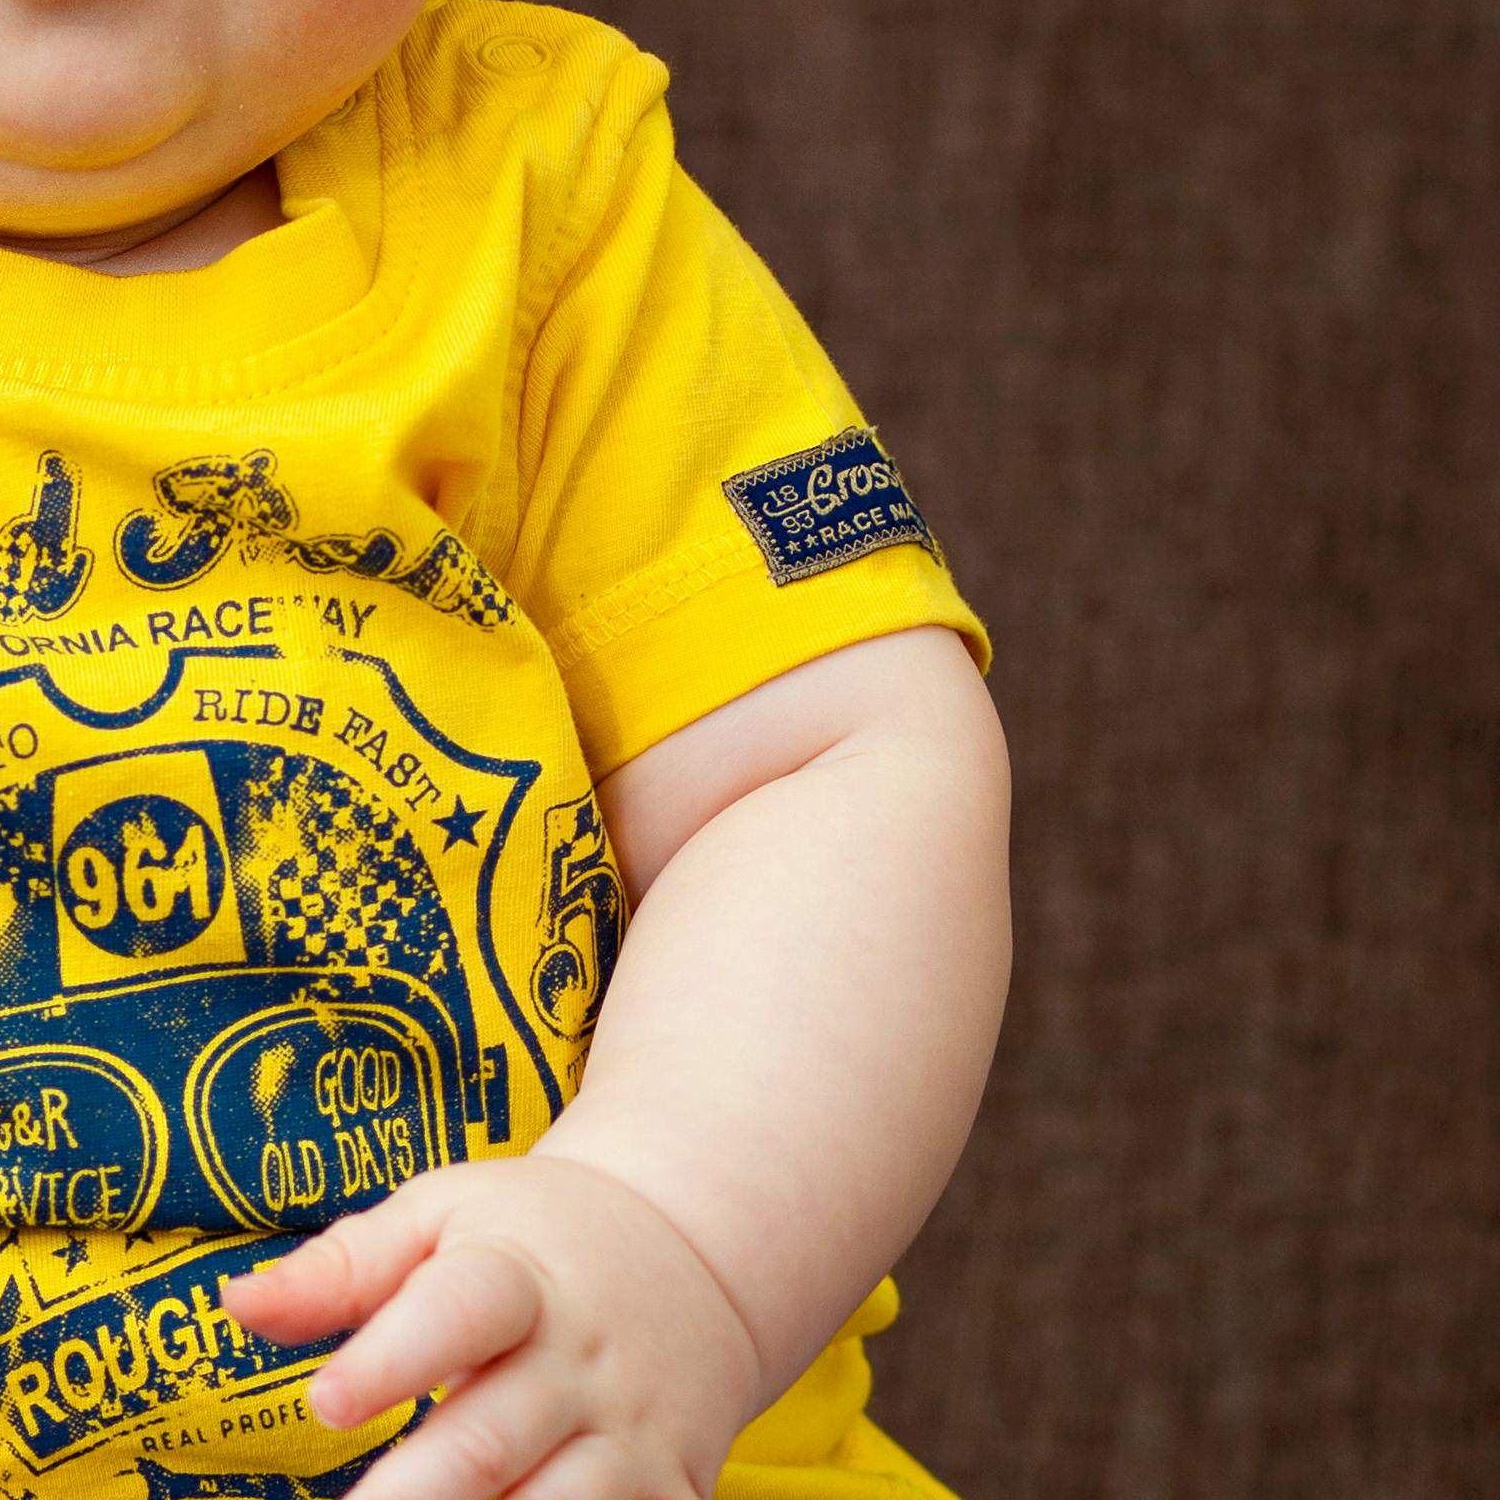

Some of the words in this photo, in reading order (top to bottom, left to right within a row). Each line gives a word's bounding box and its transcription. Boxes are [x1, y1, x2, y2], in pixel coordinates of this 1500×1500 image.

[766, 485, 799, 508] 18
[781, 510, 815, 534] 93
[819, 507, 887, 545] RACE
[147, 594, 377, 645] RACEAY
[193, 689, 324, 736] RIDE
[333, 706, 442, 812] FAST
[67, 811, 212, 930] 961
[315, 1047, 401, 1128] GOOD
[261, 1138, 326, 1212] OLD
[334, 1117, 414, 1198] DAYS
[4, 1274, 247, 1437] ROUGH
[141, 1429, 208, 1452] REAL
[220, 1398, 308, 1438] PROFE
